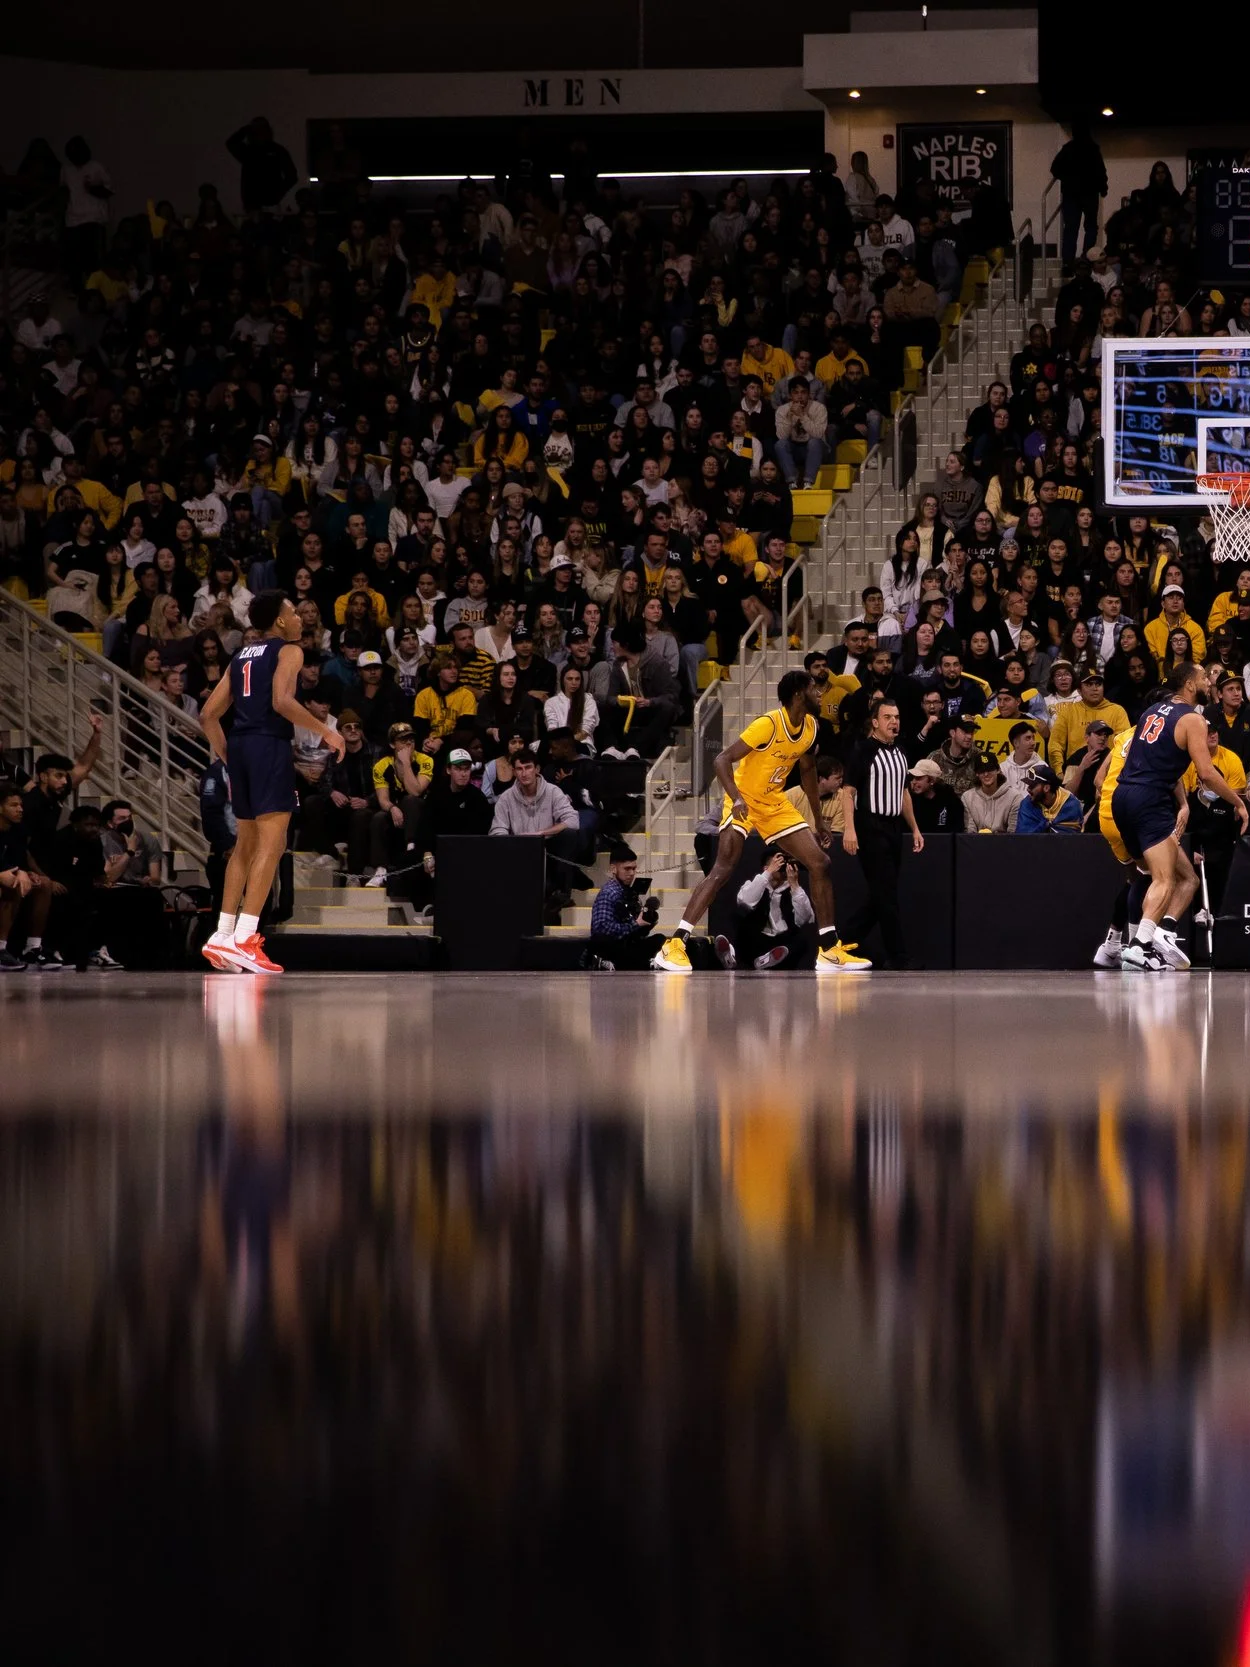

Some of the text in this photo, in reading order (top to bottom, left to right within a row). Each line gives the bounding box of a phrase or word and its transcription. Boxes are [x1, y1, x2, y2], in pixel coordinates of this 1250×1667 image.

[523, 78, 622, 107] MEN
[911, 134, 998, 160] NAPLES
[929, 155, 982, 181] RIB
[882, 233, 903, 246] ULB
[458, 606, 490, 622] CSUL
[239, 644, 268, 660] EATON
[242, 660, 253, 697] 1
[1139, 713, 1166, 744] 13
[768, 765, 788, 784] 12
